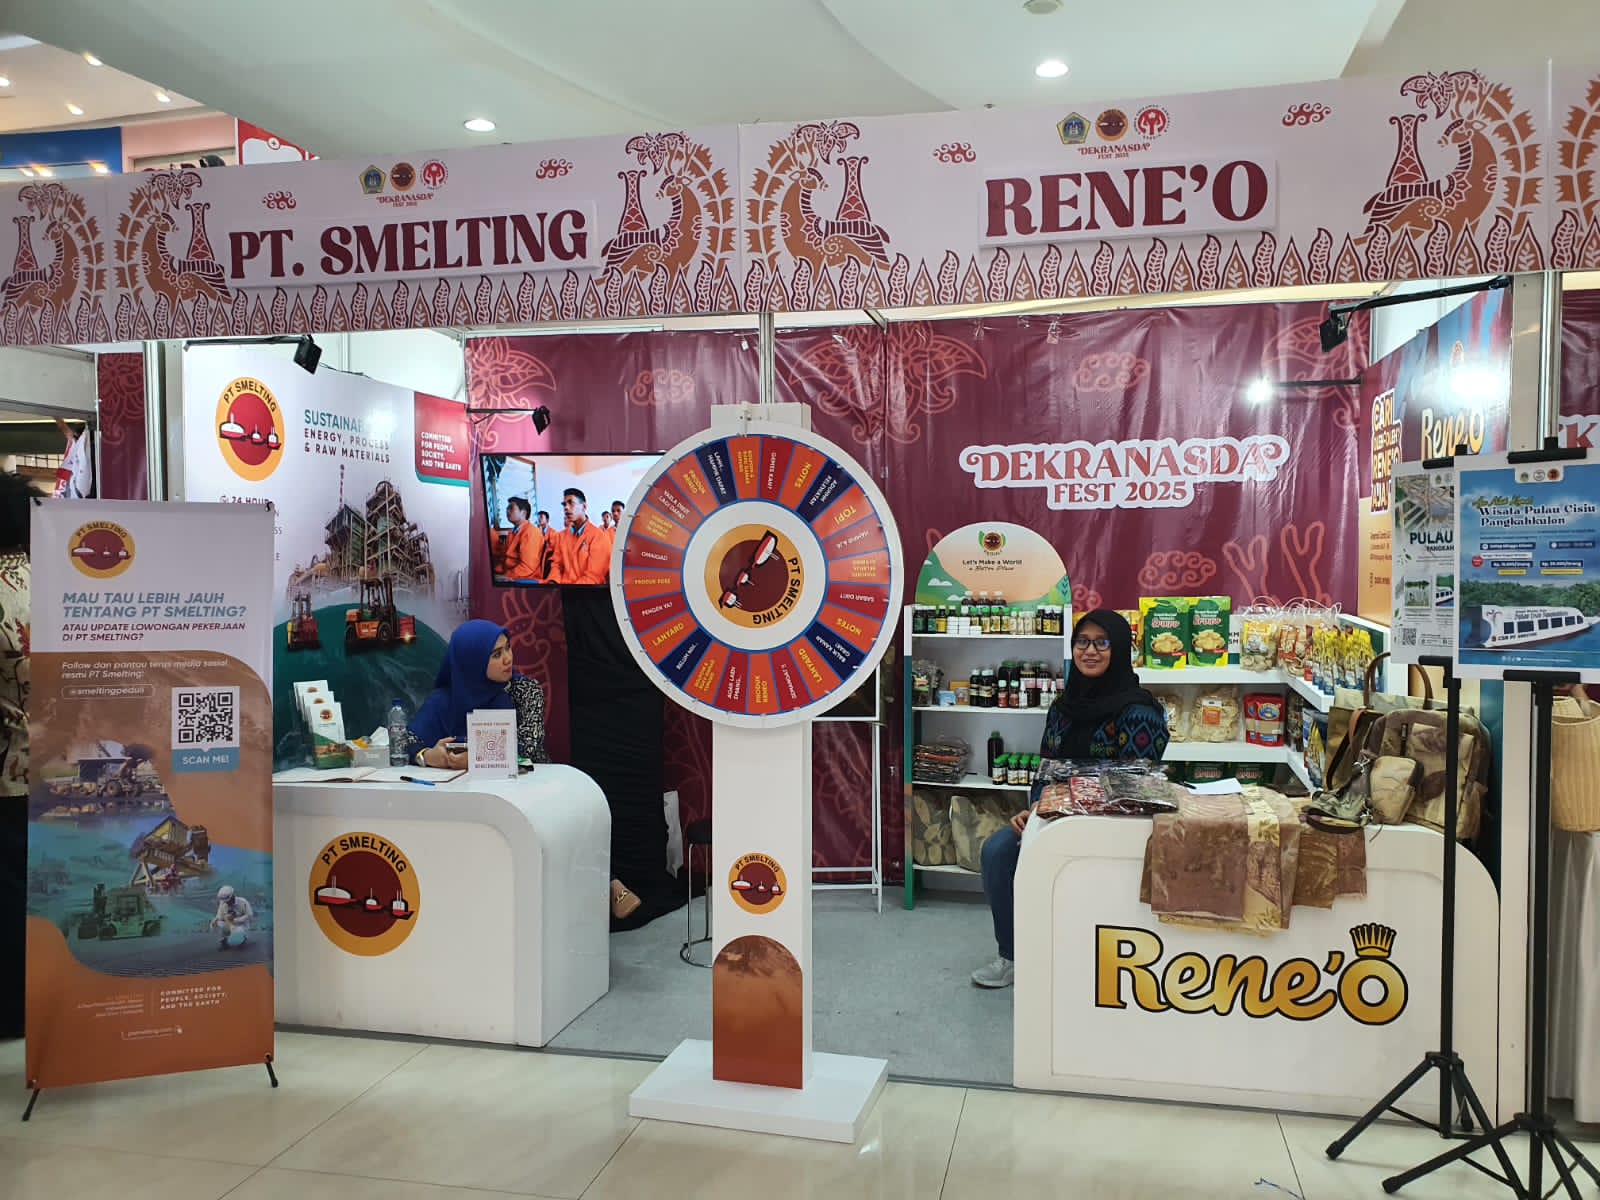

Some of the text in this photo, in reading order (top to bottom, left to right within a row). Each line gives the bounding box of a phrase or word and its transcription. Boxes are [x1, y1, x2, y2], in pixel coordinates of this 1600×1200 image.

[985, 160, 1268, 237] RENE'O
[229, 209, 588, 280] PT. SMELTING
[223, 380, 278, 413] PT SMELTING
[304, 428, 345, 445] ENERGY,
[304, 442, 390, 463] & RAW MATERIALS
[966, 442, 1282, 481] DEKRANASDA
[793, 461, 812, 489] NOTES
[1054, 482, 1187, 503] FEST 2025
[832, 504, 856, 524] TOPI
[1479, 506, 1521, 516] Wisata
[1525, 505, 1560, 514] Pulau
[1409, 531, 1452, 545] PULAU
[63, 592, 225, 604] MAU TAU LEBIH JAUH
[753, 557, 801, 625] PT SMELTING
[64, 606, 247, 617] TENTANG PT SMELTING?
[62, 622, 246, 631] ATAU UPDATE LOWONGAN PEKERJAAN
[651, 621, 685, 646] LANYARD
[835, 617, 862, 635] NOTES
[62, 632, 144, 641] DI PT SMELTING?
[88, 671, 100, 679] PT
[797, 647, 823, 683] LANYARD
[182, 755, 230, 765] SCAN ME!
[322, 835, 407, 874] PT SMELTING
[735, 855, 780, 873] PT SMELTING
[1095, 924, 1409, 1026] Rene'O
